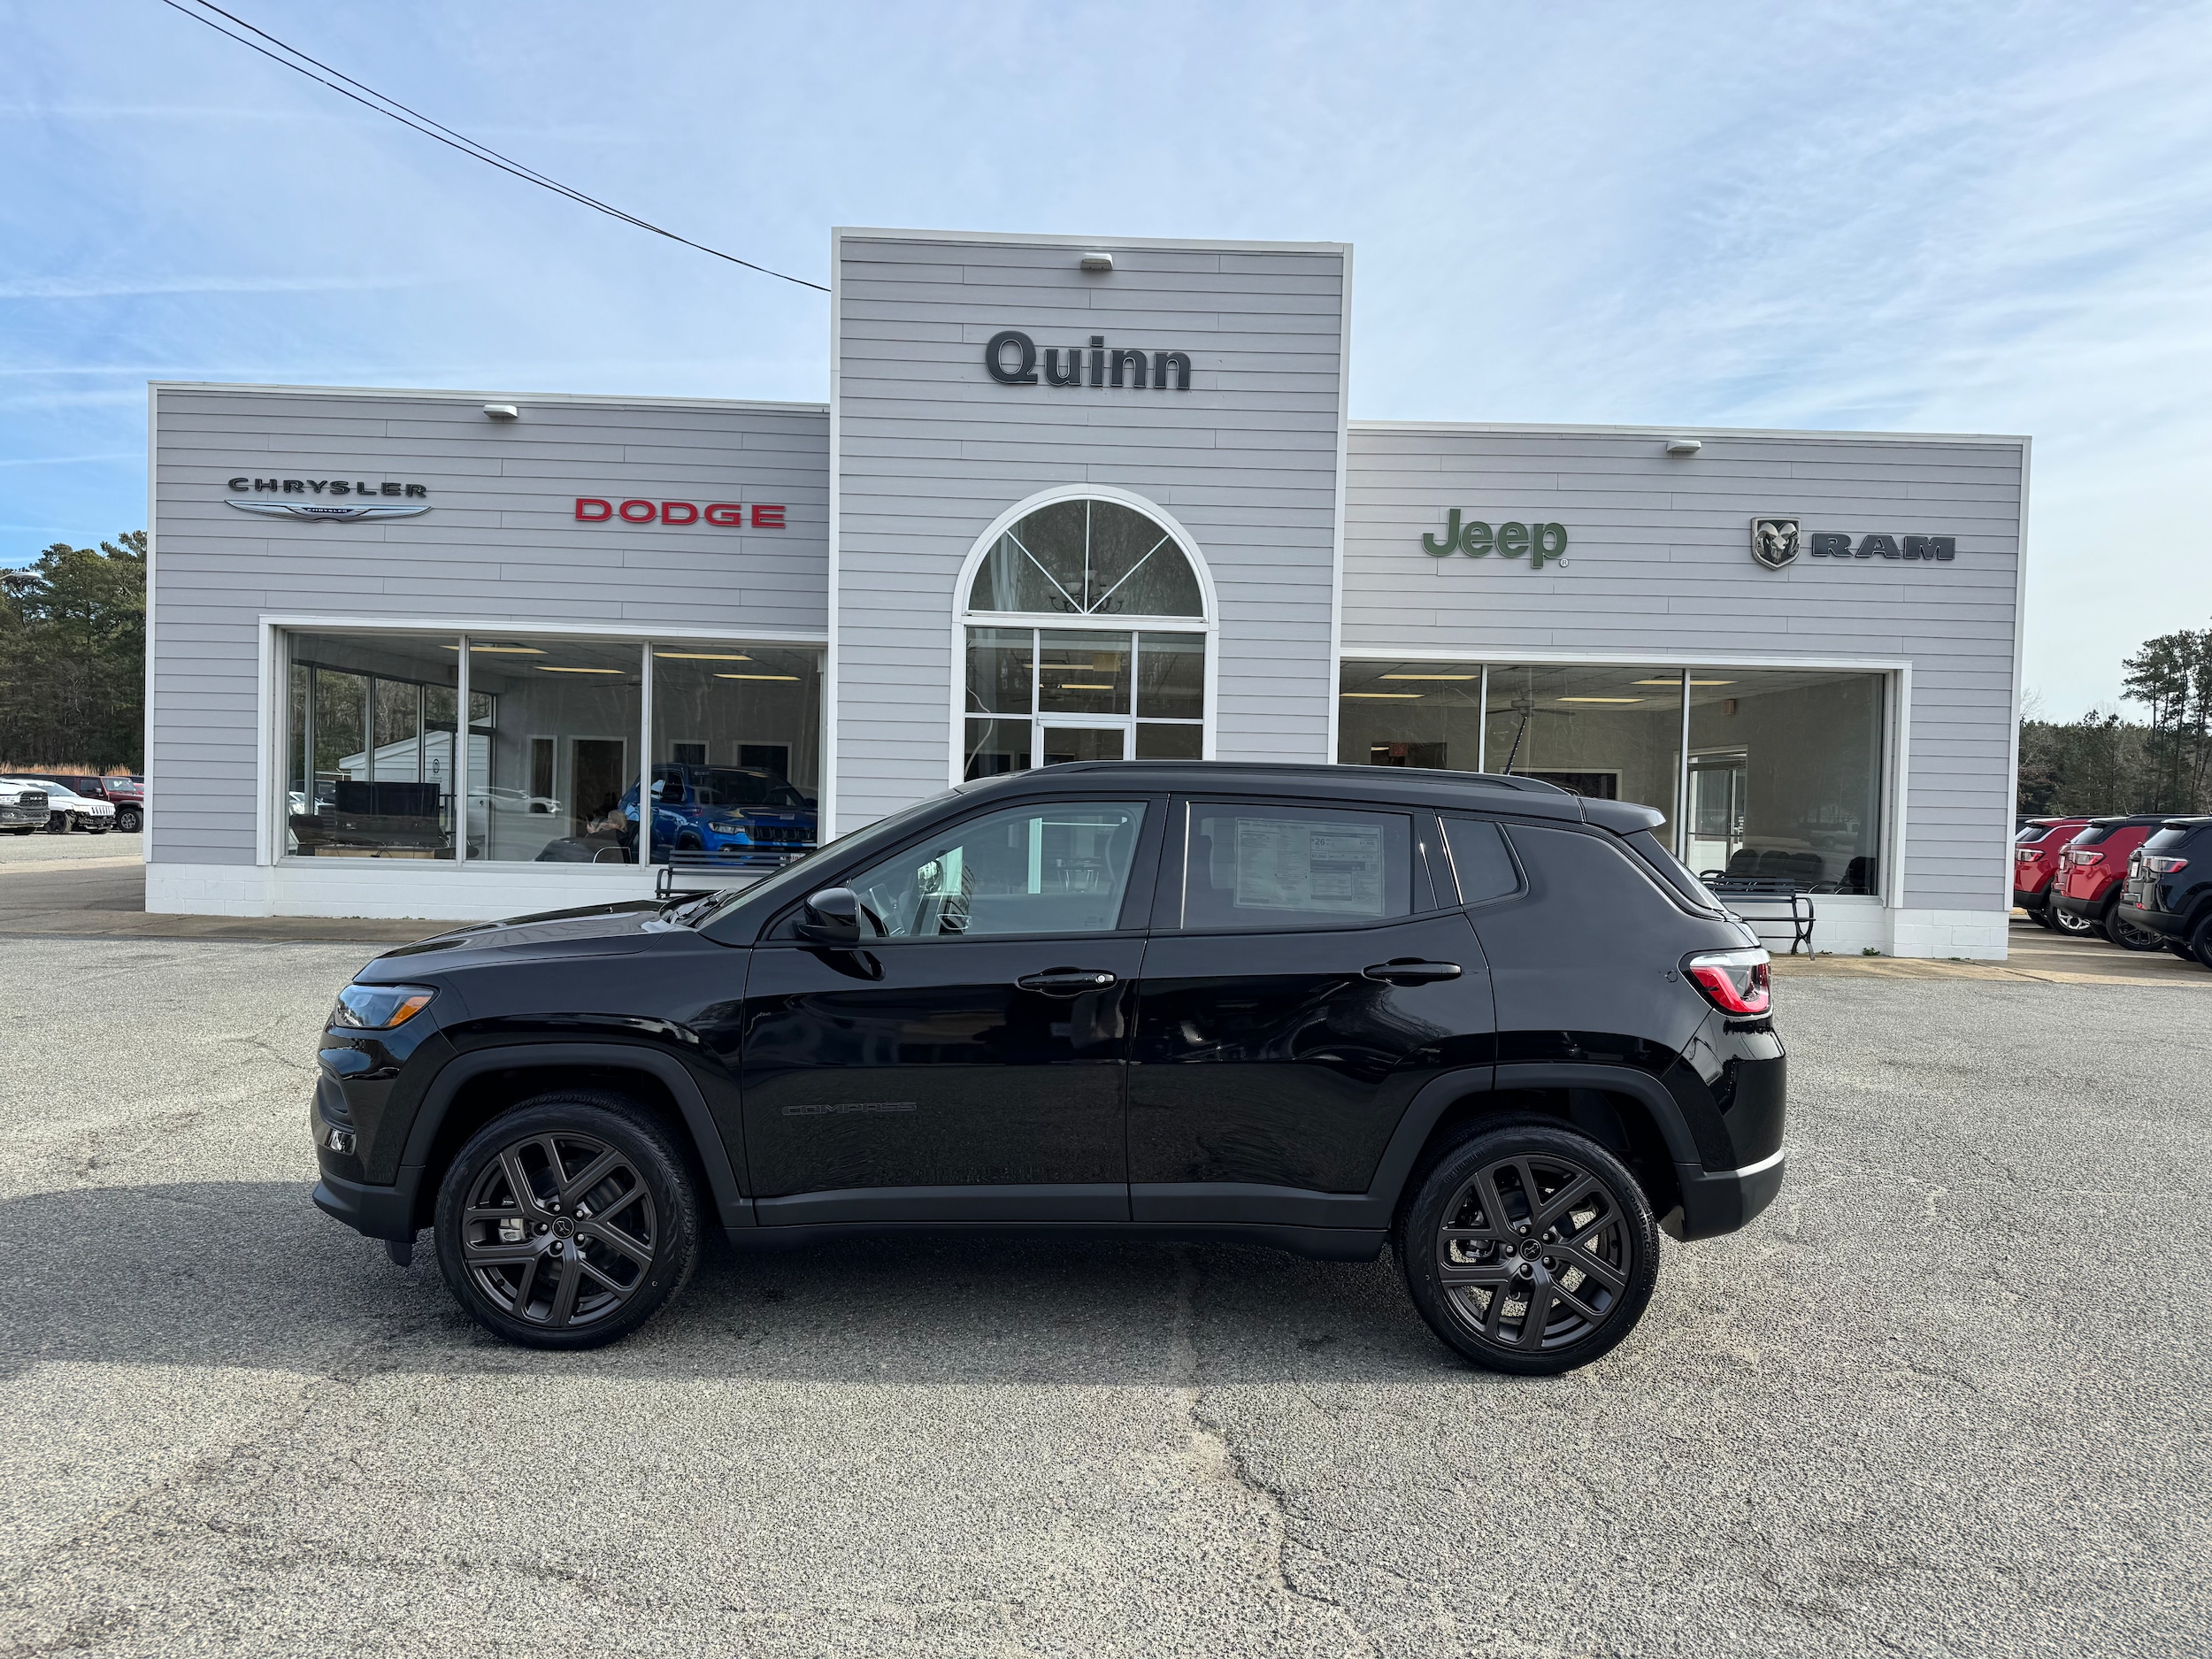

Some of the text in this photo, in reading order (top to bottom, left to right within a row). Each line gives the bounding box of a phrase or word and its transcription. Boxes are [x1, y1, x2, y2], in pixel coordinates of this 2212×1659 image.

[986, 330, 1191, 389] Quinn
[227, 477, 426, 498] CHRYSLER
[575, 497, 786, 529] DODGE
[1421, 508, 1568, 569] Jeep
[1811, 533, 1956, 560] RAM
[782, 1101, 918, 1116] COMPASS
